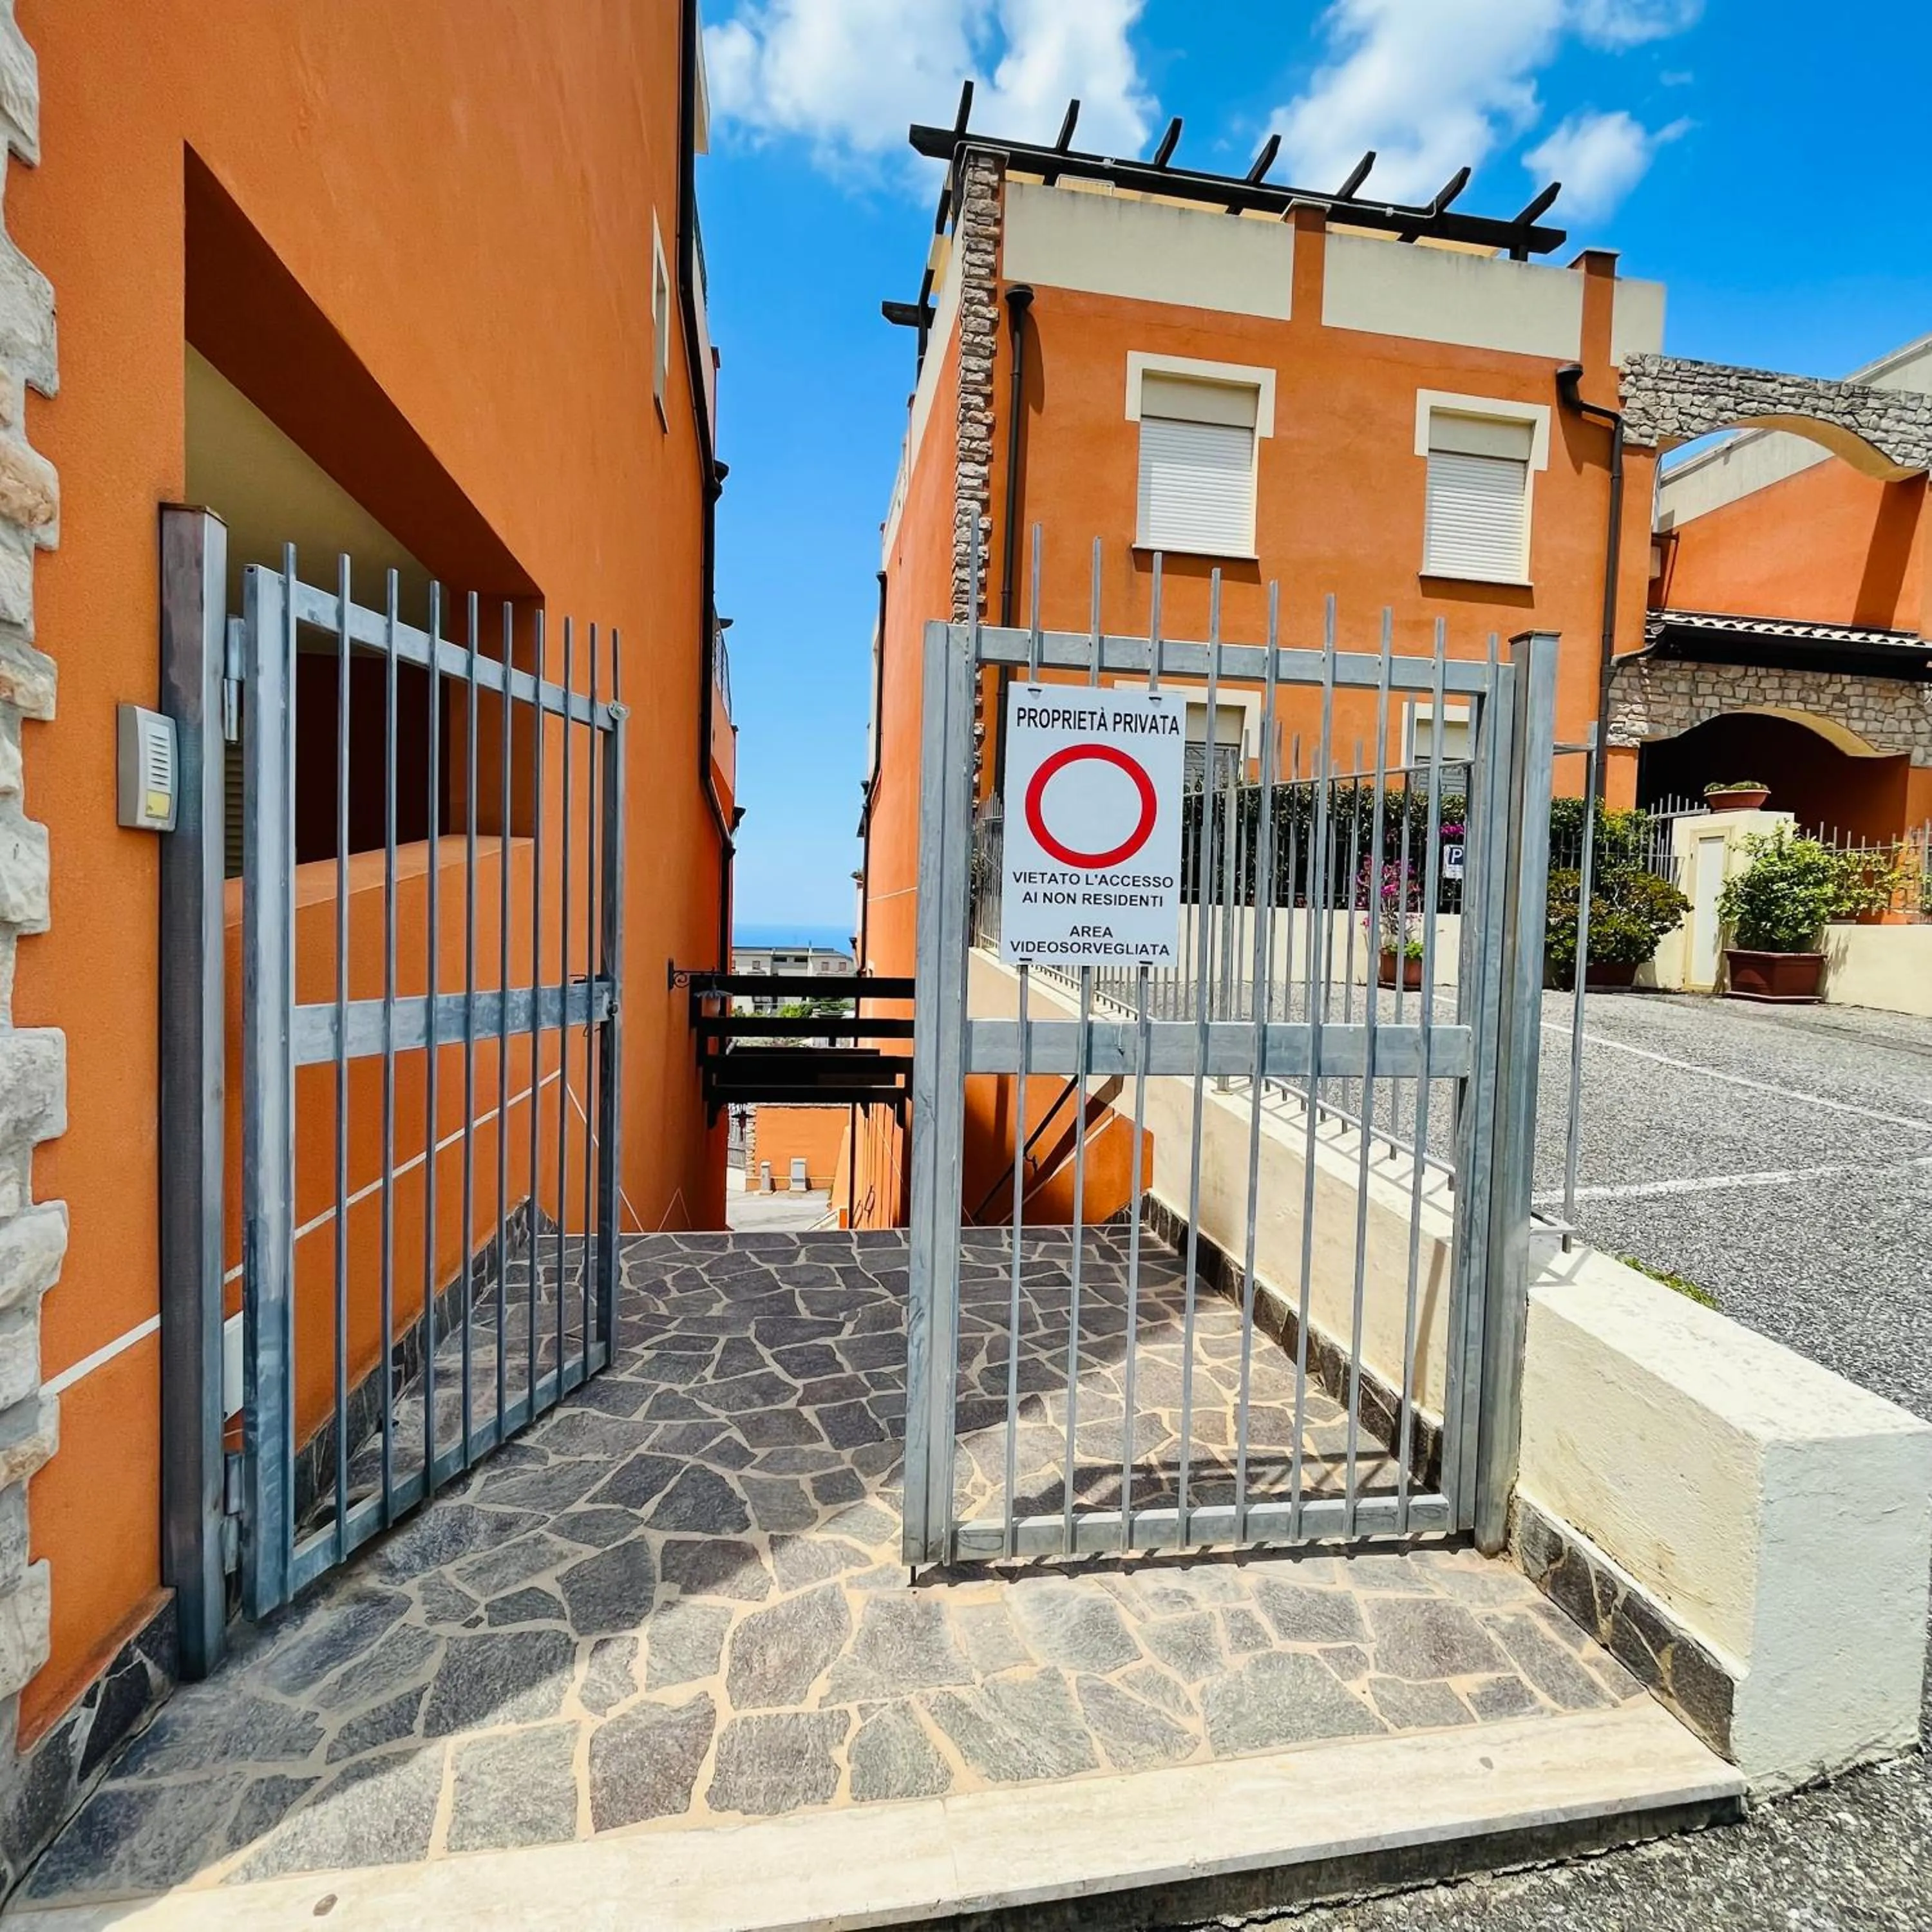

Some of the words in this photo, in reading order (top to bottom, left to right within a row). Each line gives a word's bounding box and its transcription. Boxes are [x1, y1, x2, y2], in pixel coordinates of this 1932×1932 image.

[1016, 706, 1108, 731] PROPRIETÀ
[1113, 712, 1180, 735] PRIVATA
[1451, 848, 1463, 864] P
[1013, 871, 1080, 886] VIETATO
[1085, 873, 1174, 889] L'ACCESSO
[1022, 892, 1037, 904] AI
[1043, 892, 1077, 905] NON
[1082, 893, 1163, 907] RESIDENTI
[1070, 925, 1113, 938] AREA
[1010, 941, 1170, 956] VIDEOSORVEGLIATA
